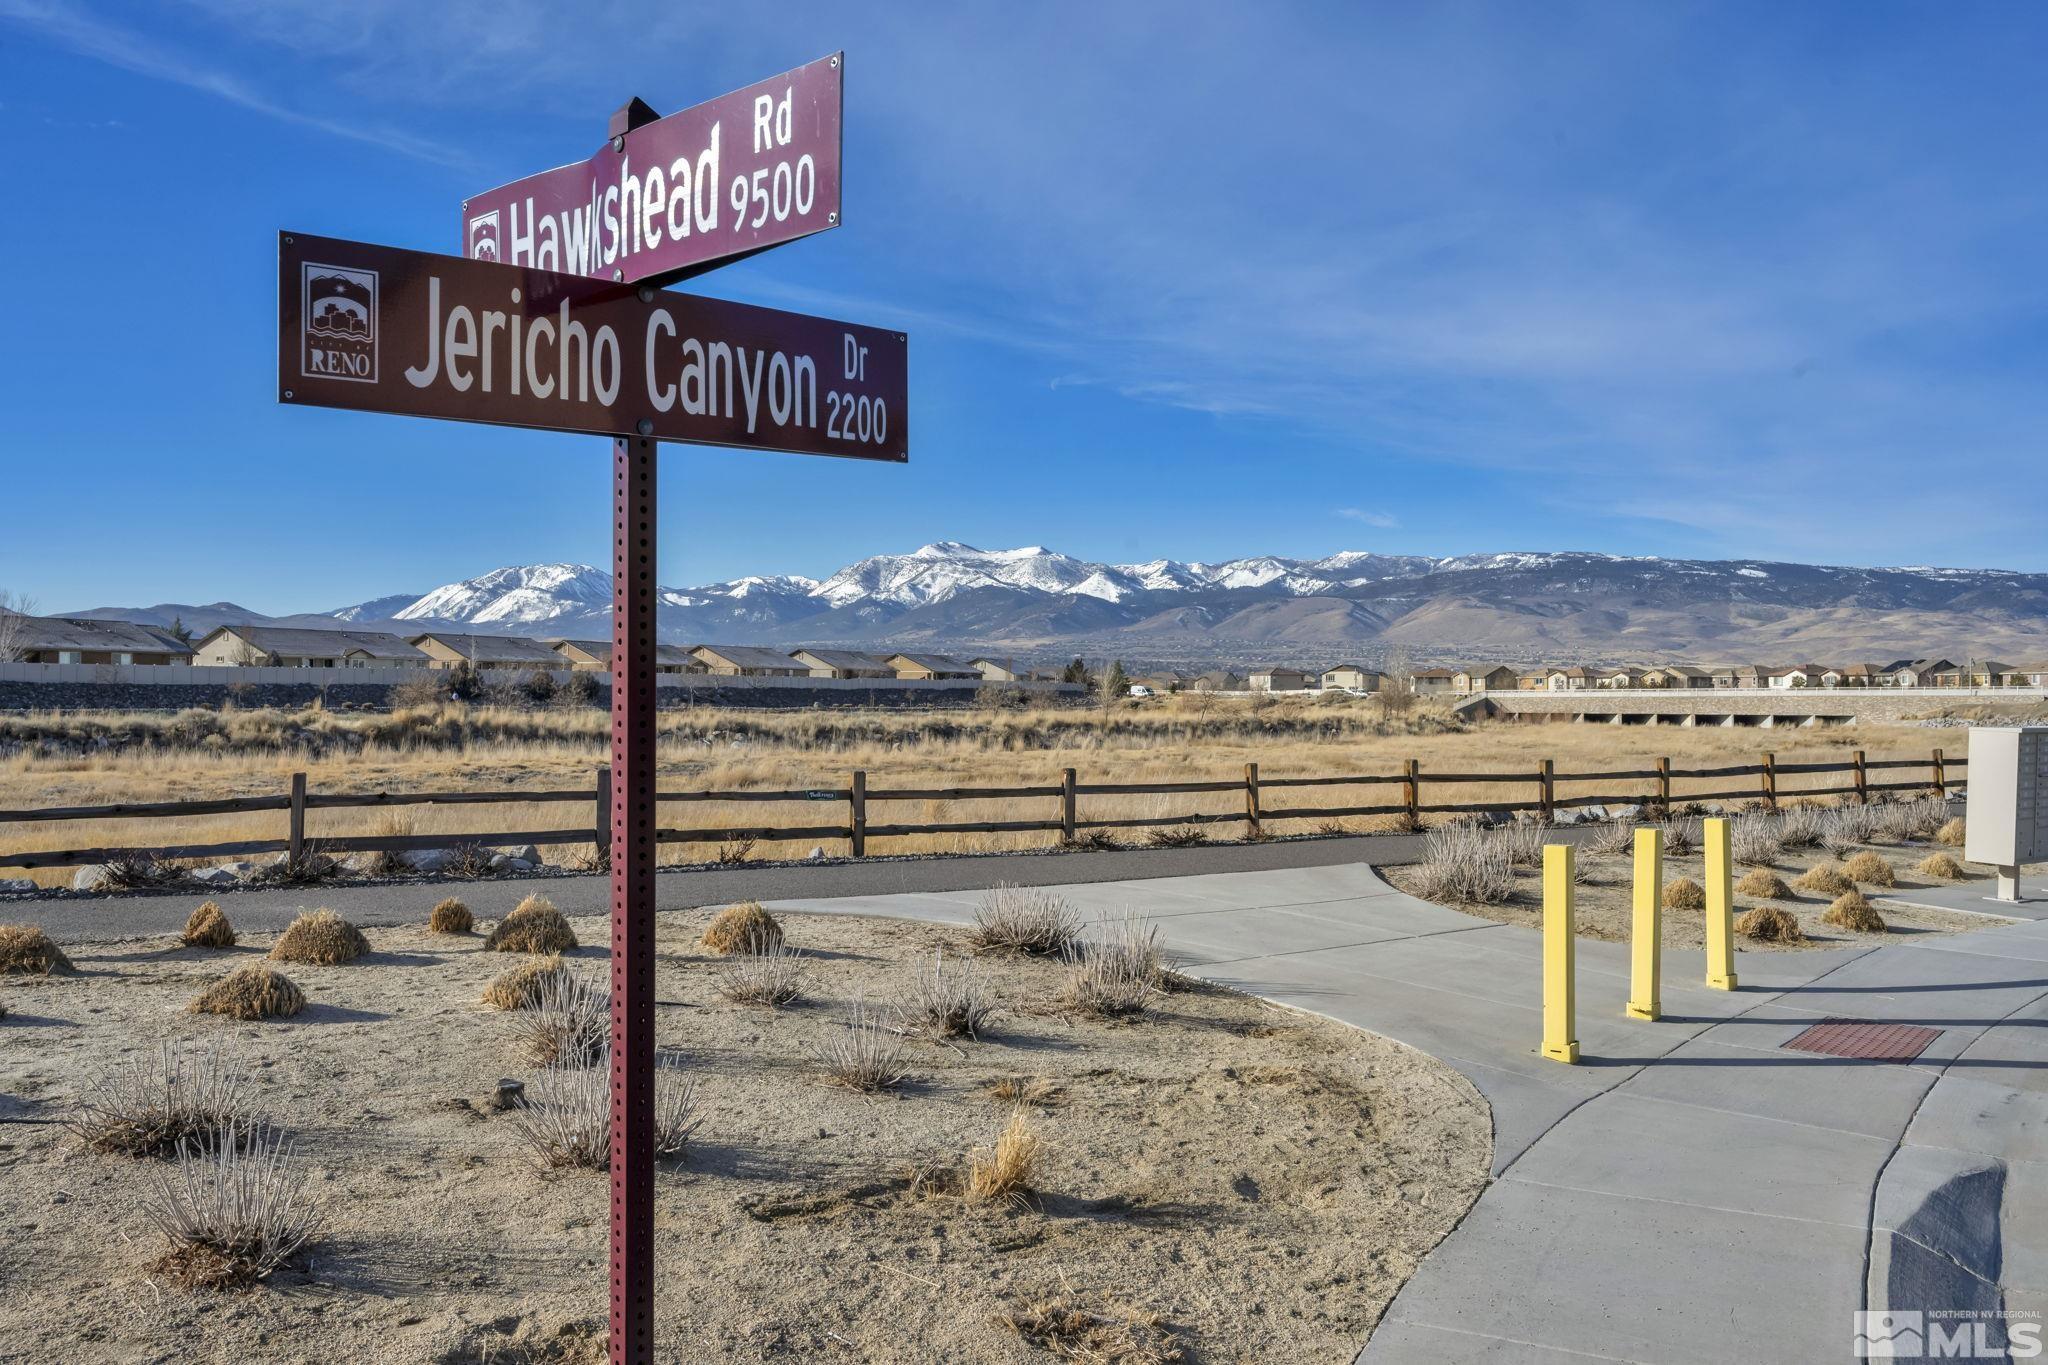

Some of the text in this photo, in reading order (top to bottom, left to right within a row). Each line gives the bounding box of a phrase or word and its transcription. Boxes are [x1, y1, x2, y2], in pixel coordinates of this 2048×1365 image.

[754, 86, 792, 153] Rd
[510, 120, 720, 277] Hawkshead
[730, 154, 815, 232] 9500
[309, 348, 370, 376] RENO
[404, 276, 817, 434] Jericho Canyon
[844, 333, 869, 382] Dr
[826, 390, 887, 445] 2200
